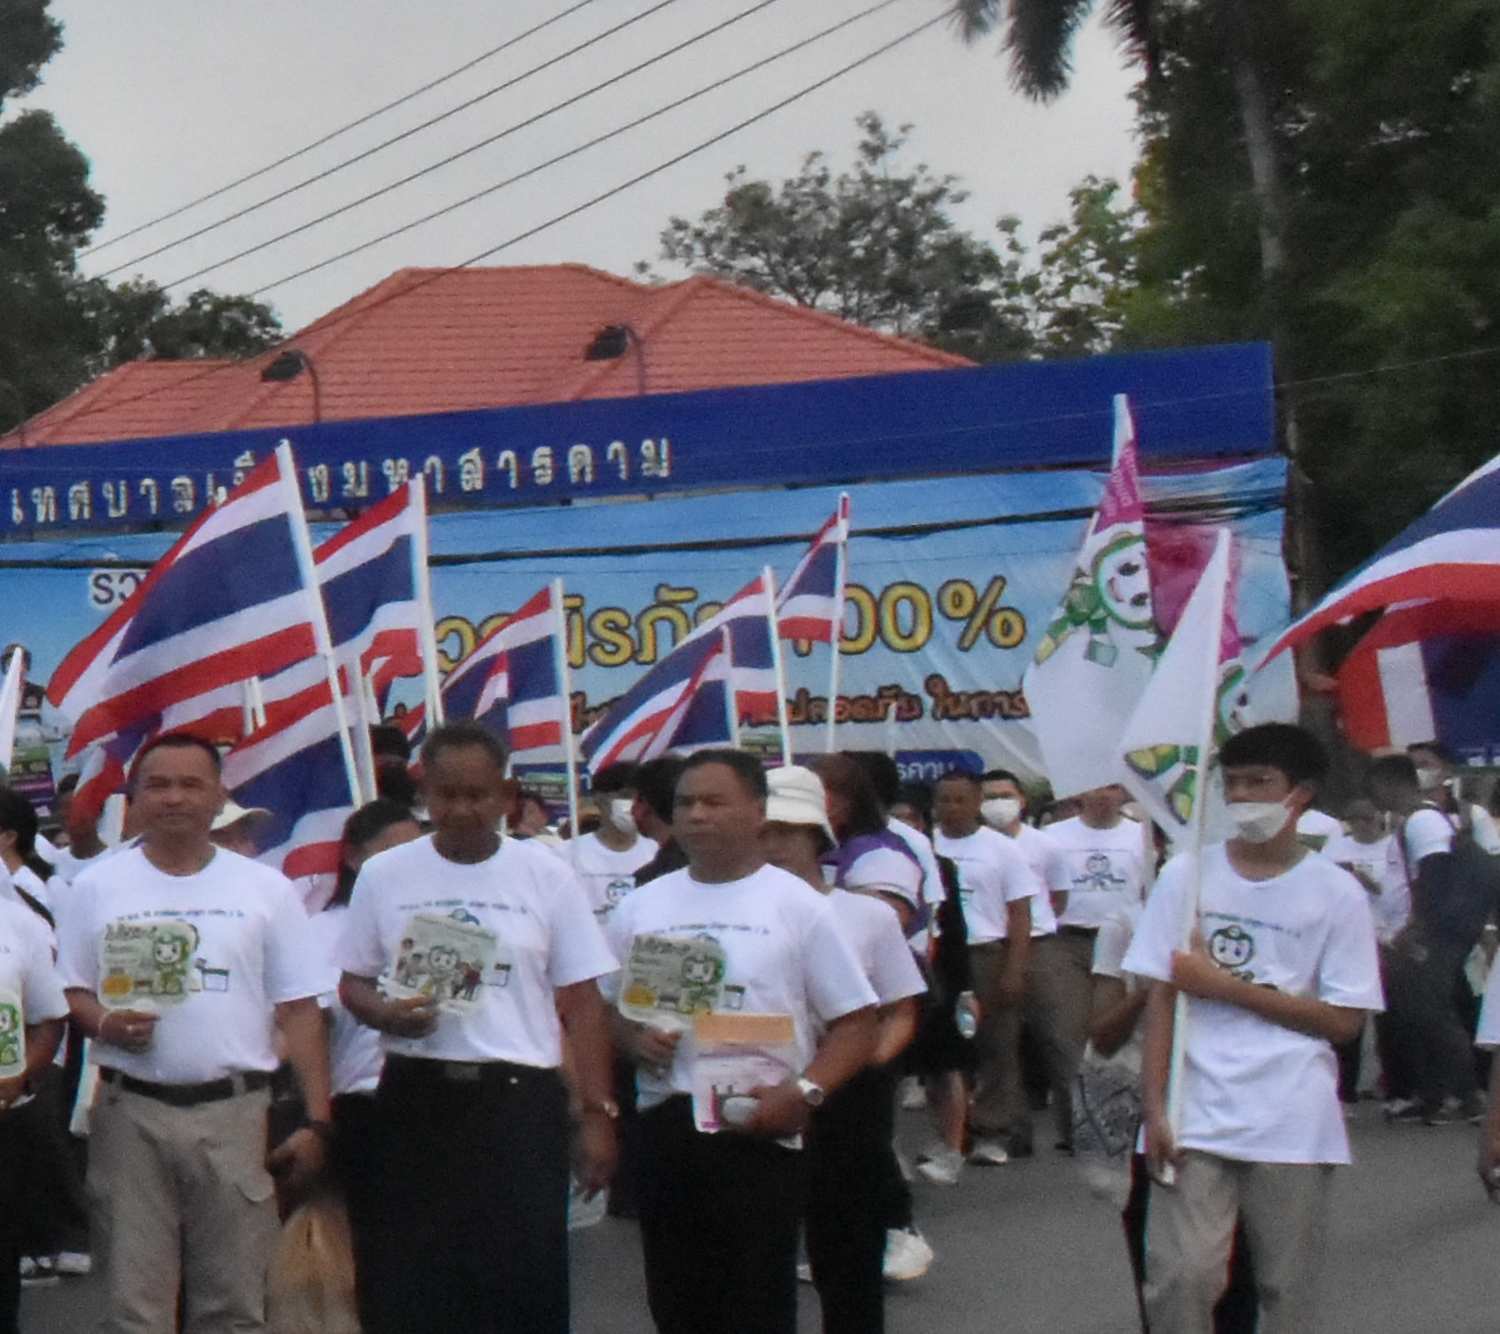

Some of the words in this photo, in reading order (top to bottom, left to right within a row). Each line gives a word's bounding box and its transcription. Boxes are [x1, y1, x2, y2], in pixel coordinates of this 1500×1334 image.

[9, 437, 672, 524] เทศบาลเืงมหาสารคาม
[792, 575, 1026, 657] 00%
